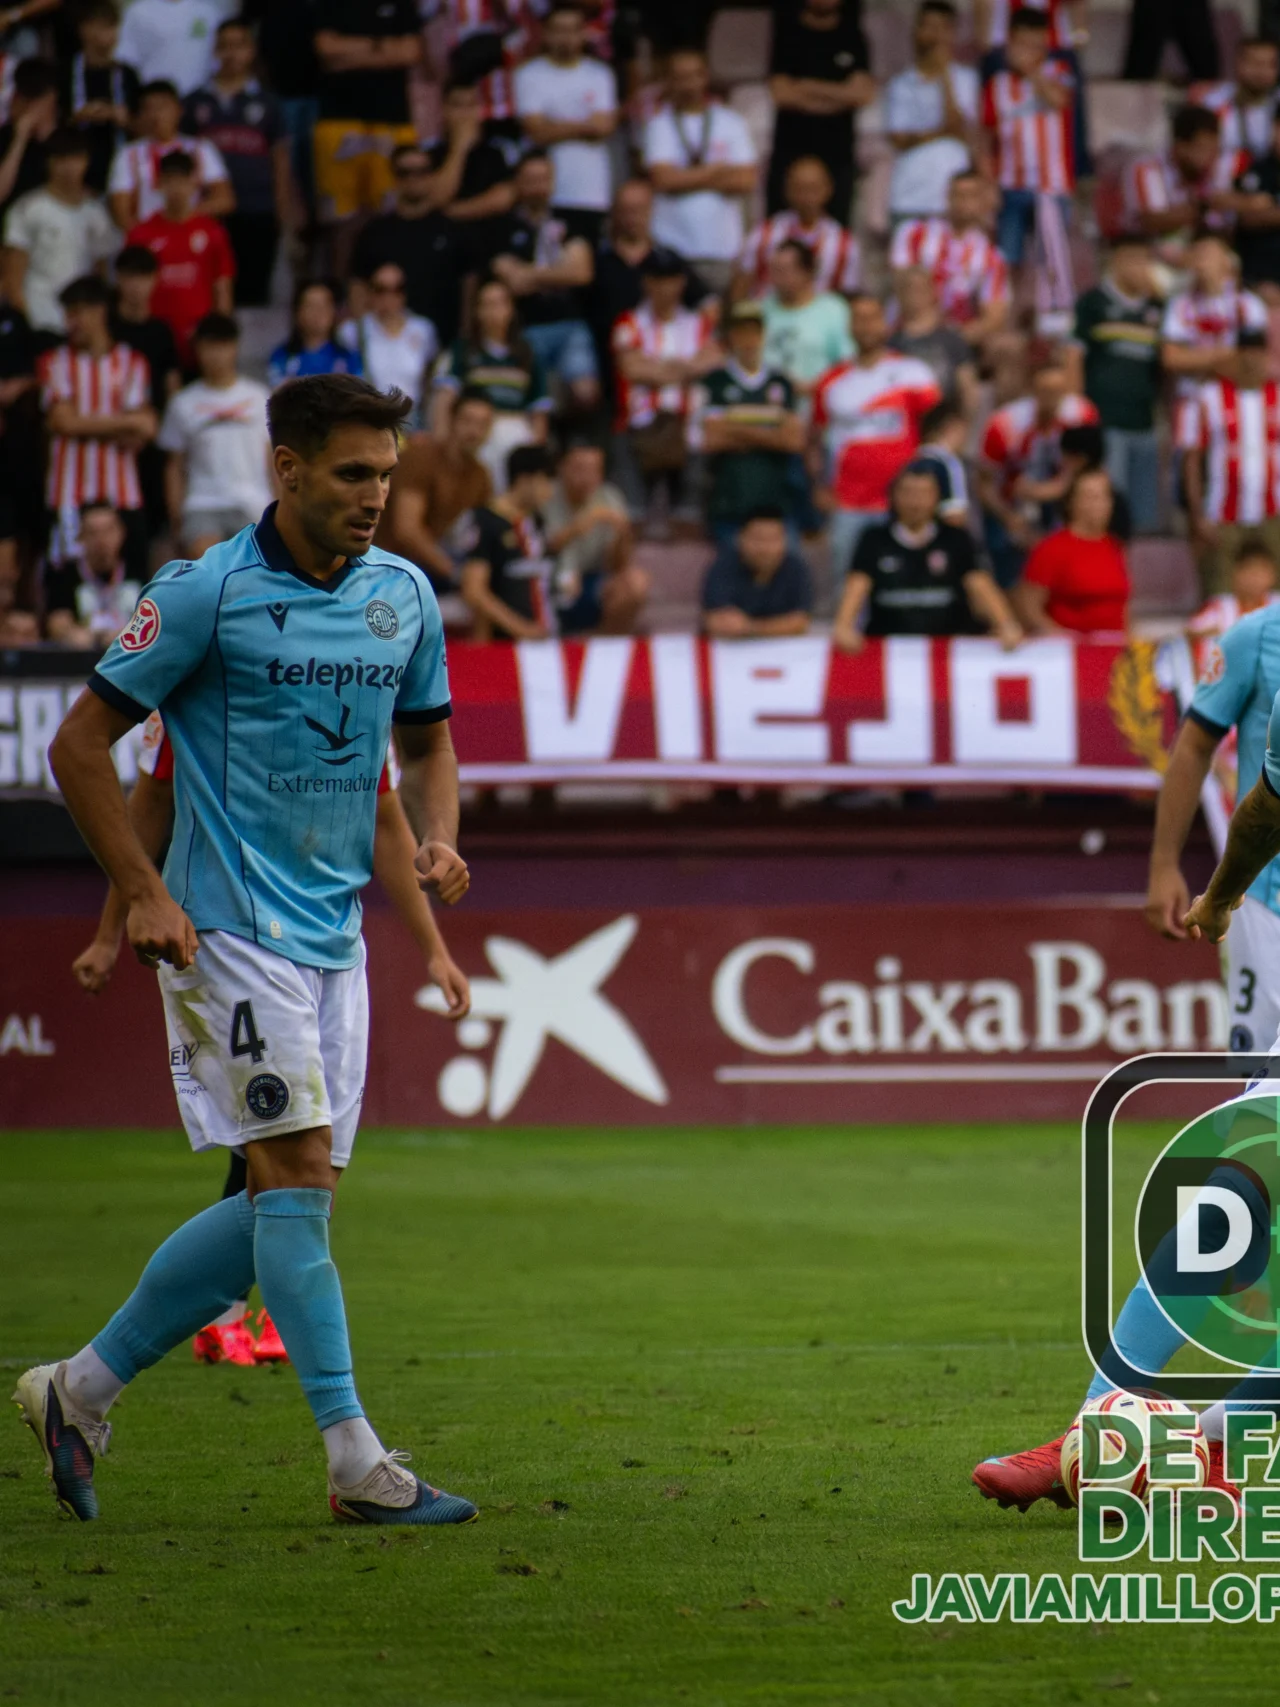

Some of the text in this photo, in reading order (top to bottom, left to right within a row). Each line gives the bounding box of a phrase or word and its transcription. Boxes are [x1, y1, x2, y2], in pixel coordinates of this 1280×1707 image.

[267, 772, 377, 794] Extremadur
[711, 936, 1226, 1057] CaixaBan
[1234, 966, 1257, 1014] 3
[230, 997, 268, 1065] 4
